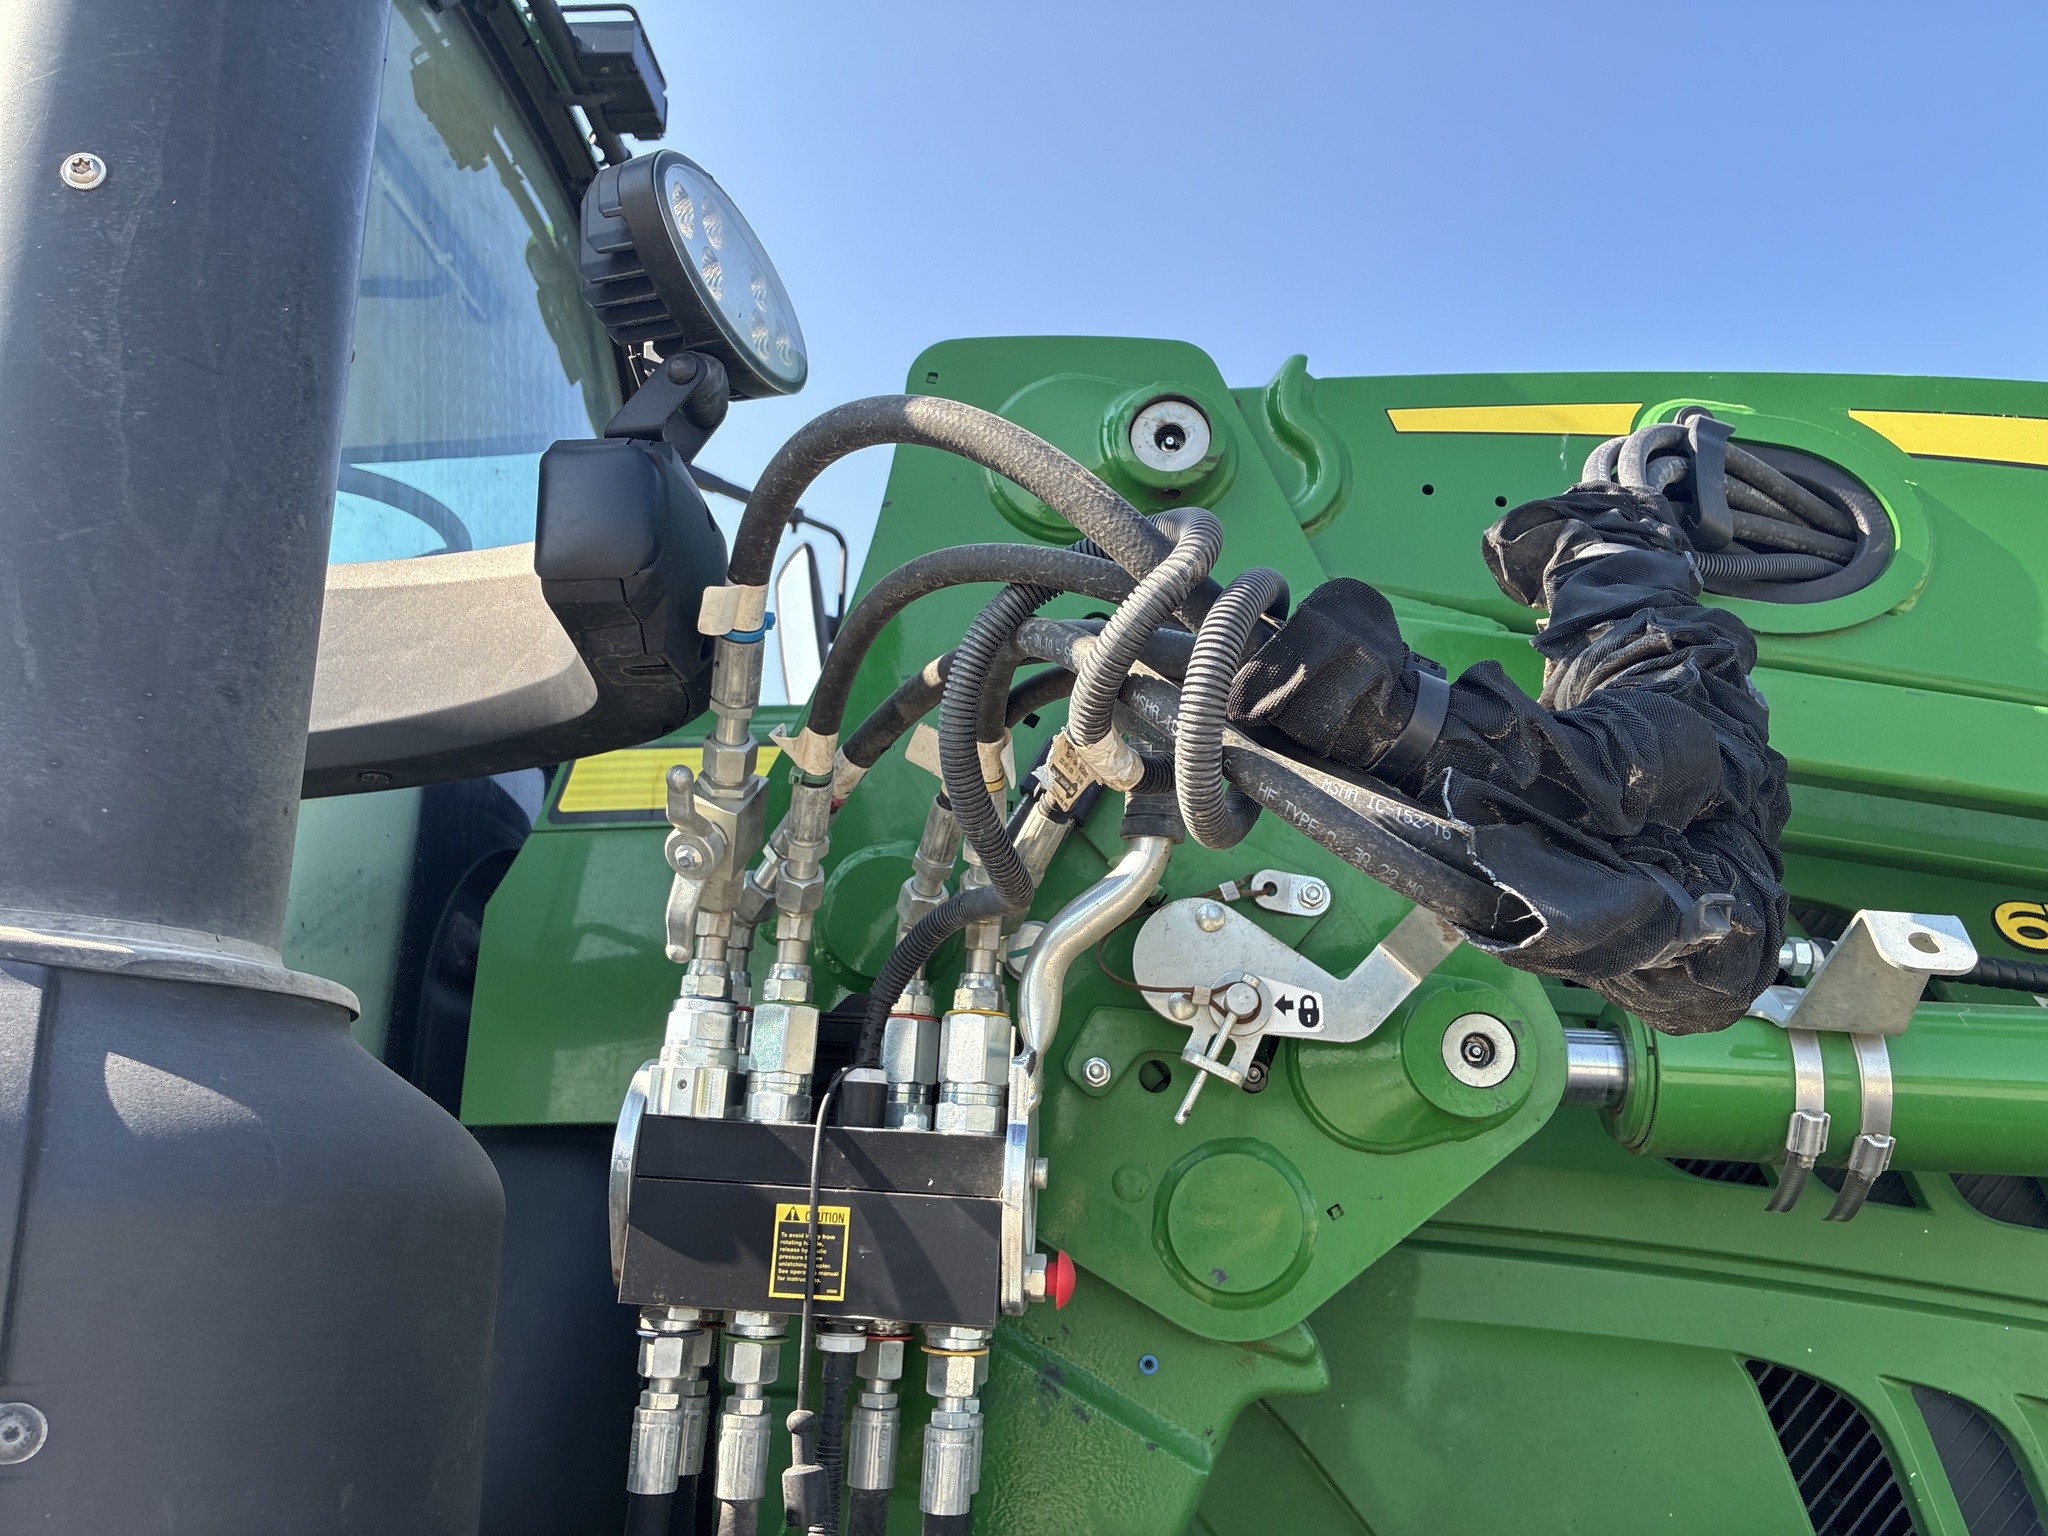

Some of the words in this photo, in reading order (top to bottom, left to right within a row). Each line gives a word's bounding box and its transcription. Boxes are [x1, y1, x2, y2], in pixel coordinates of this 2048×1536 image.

[1284, 799, 1320, 835] TYPE
[1321, 777, 1359, 803] MSHA
[1366, 794, 1452, 841] IC-152/16
[1991, 901, 2048, 953] 6
[805, 1211, 845, 1223] CUTION
[778, 1261, 807, 1269] unlatching
